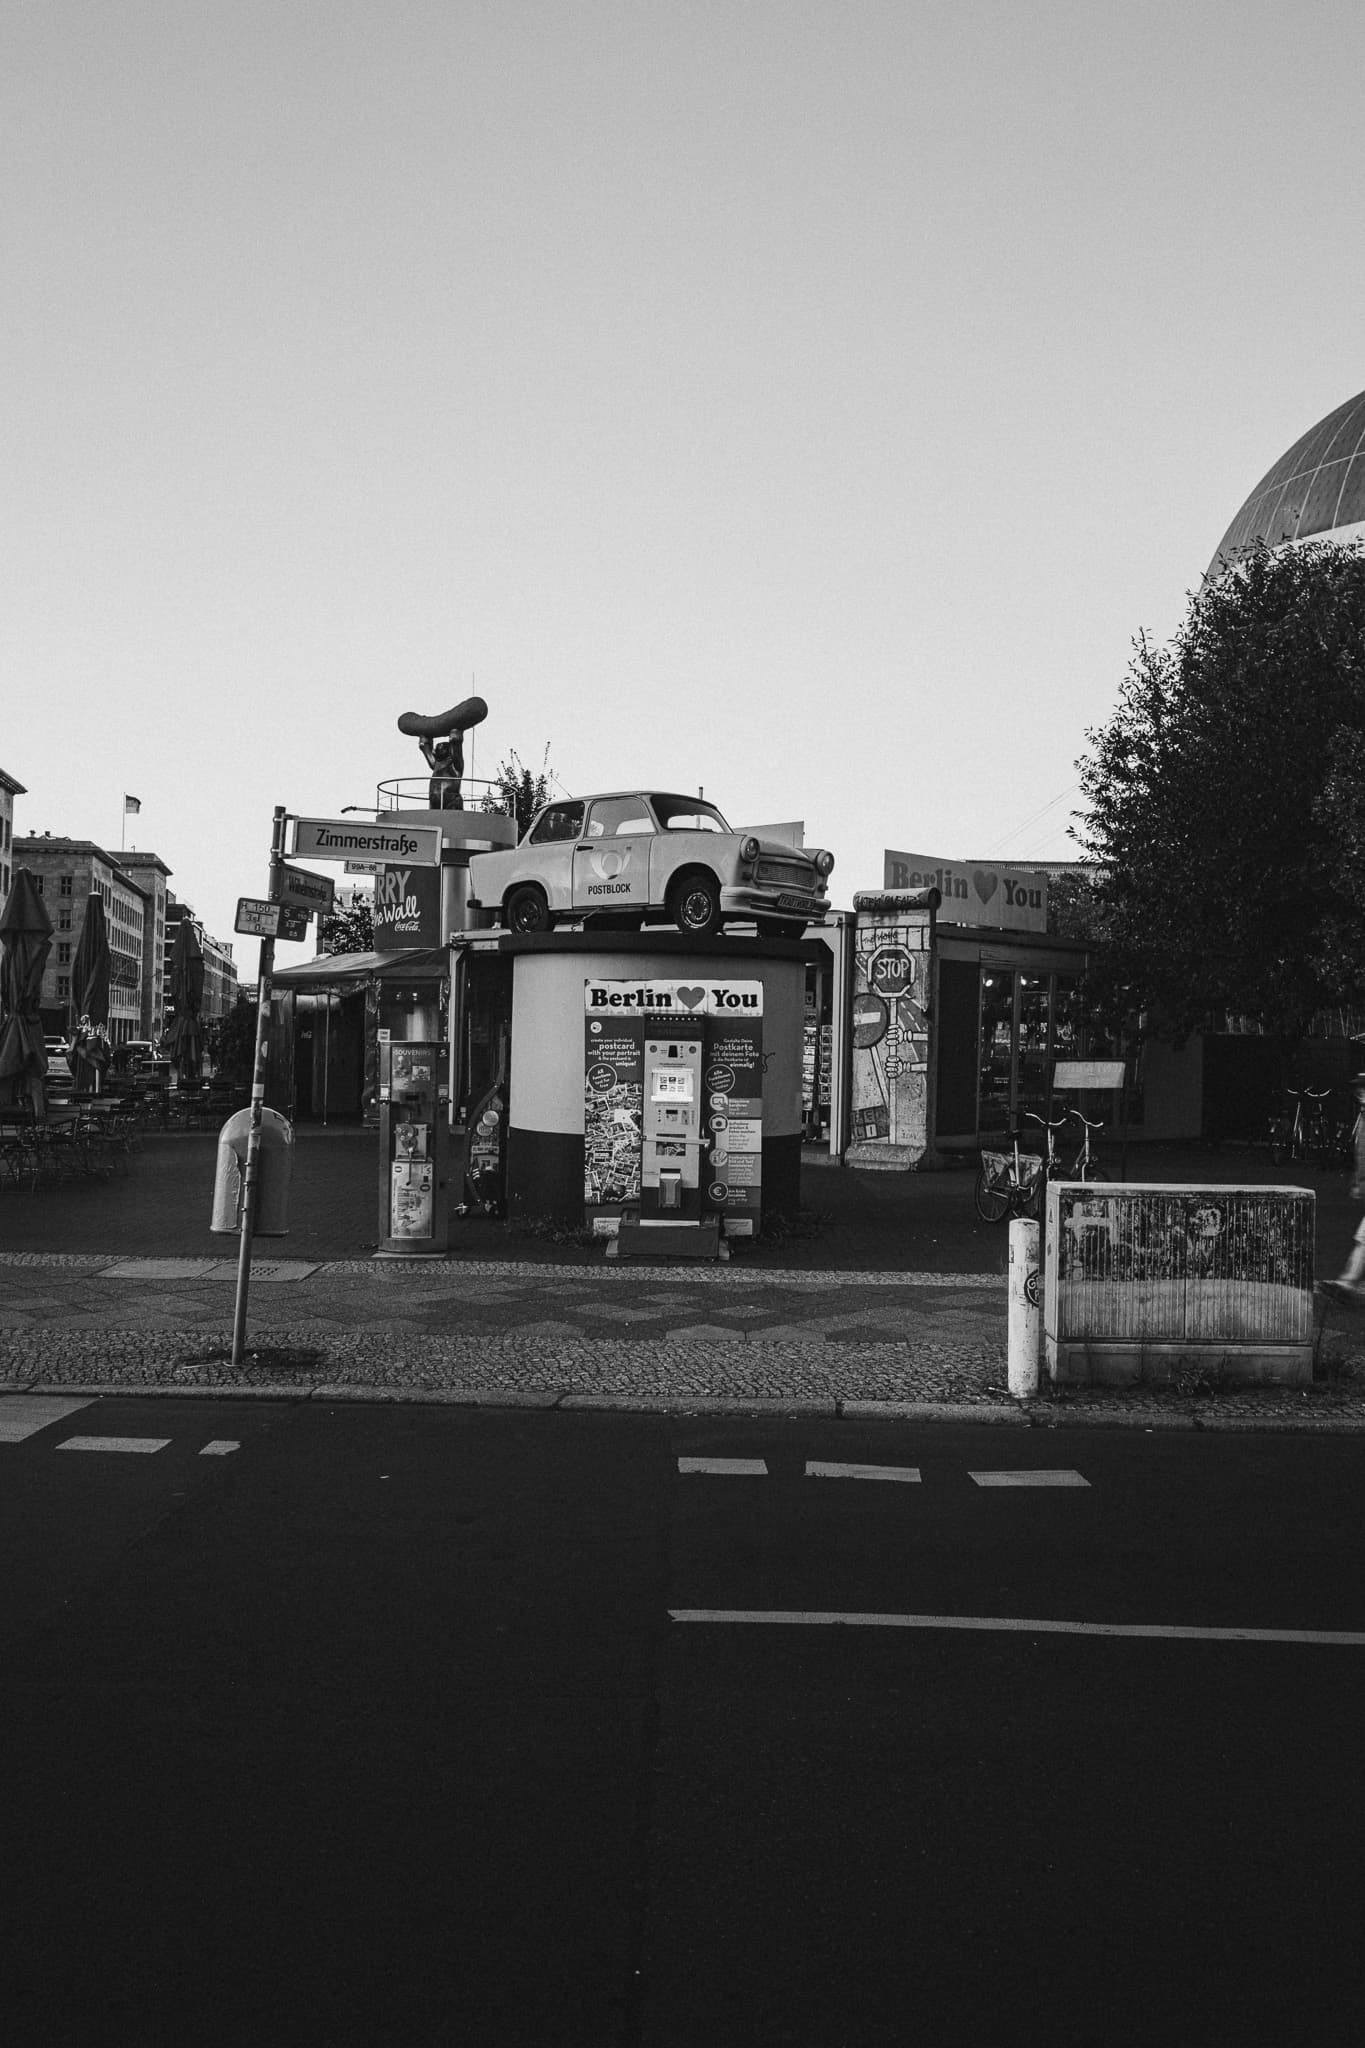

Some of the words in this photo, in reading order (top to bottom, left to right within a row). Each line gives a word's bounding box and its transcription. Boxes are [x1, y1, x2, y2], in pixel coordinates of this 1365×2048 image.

[316, 829, 418, 855] Zimmerstraße
[588, 883, 631, 895] POSTBLOCK
[891, 861, 969, 899] Berlin
[1003, 879, 1042, 908] You
[255, 904, 270, 913] 150
[383, 896, 421, 923] Wall
[876, 958, 909, 979] STOP
[590, 989, 672, 1007] Berlin
[711, 989, 759, 1007] You
[394, 1048, 431, 1056] SOUVENIRS
[599, 1042, 635, 1051] postcard
[713, 1043, 754, 1051] Postkarte
